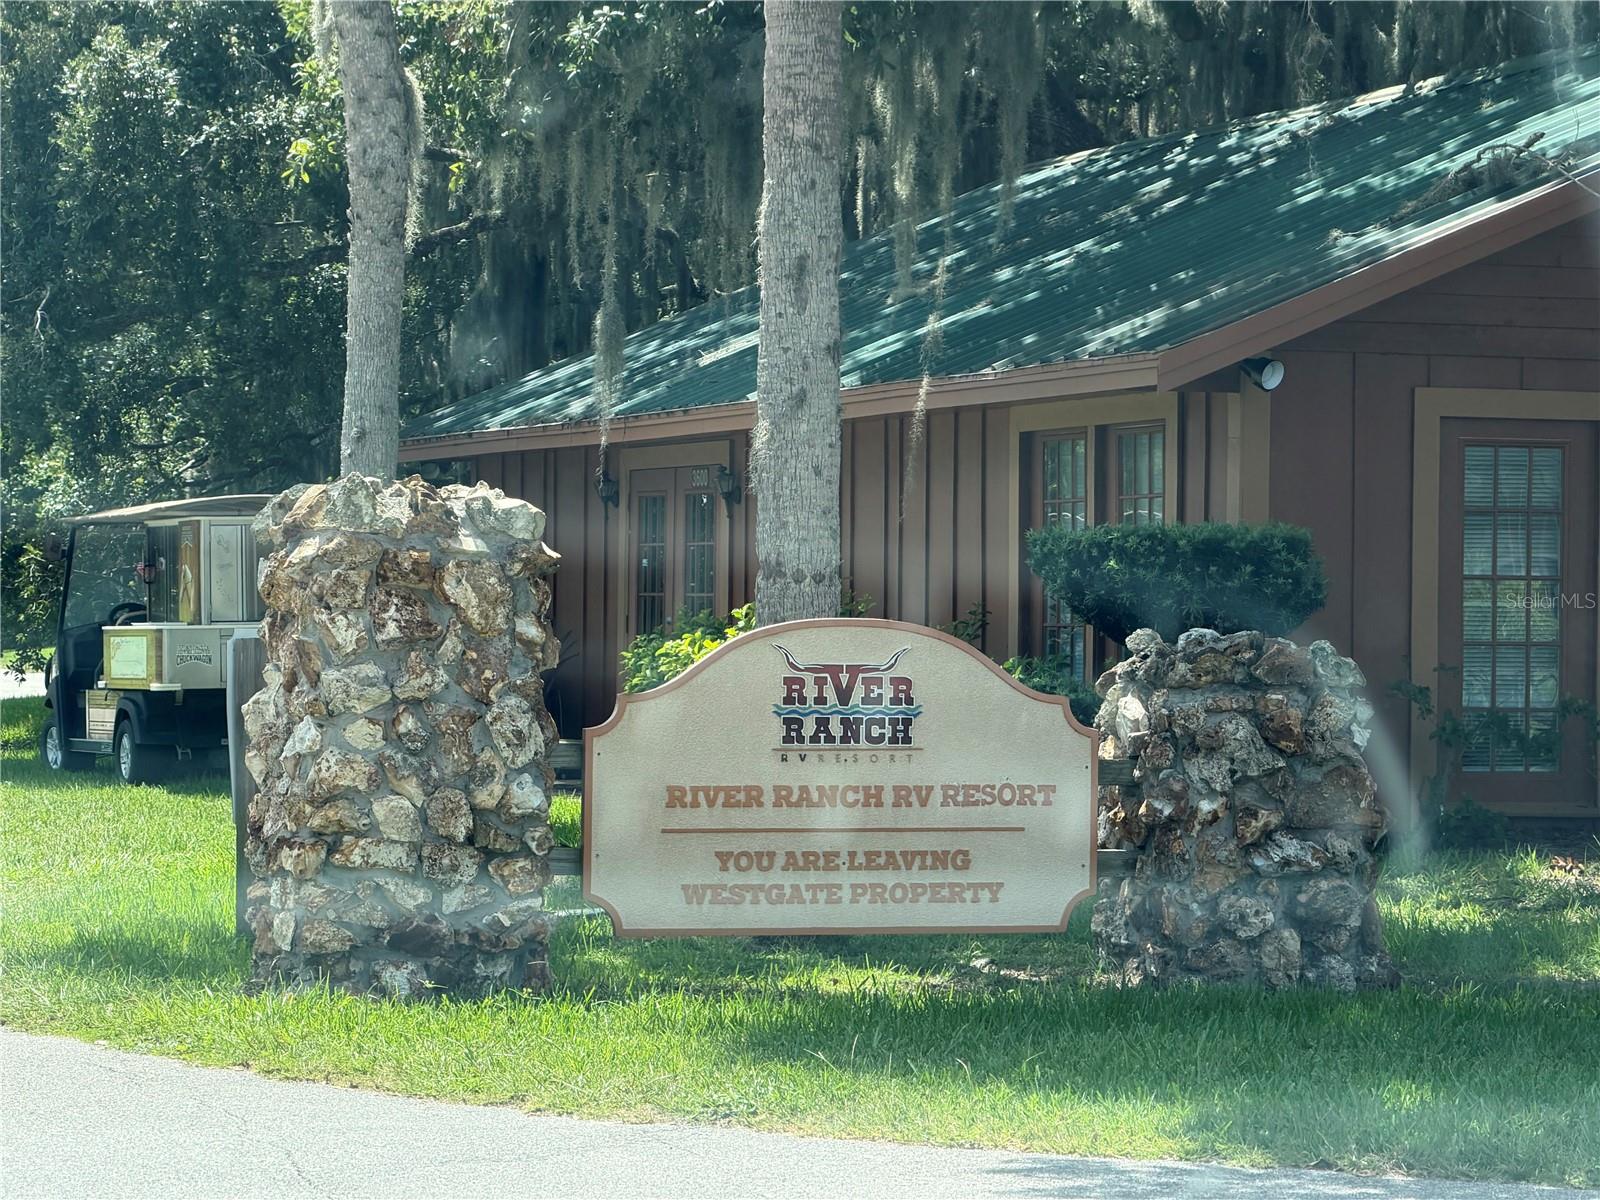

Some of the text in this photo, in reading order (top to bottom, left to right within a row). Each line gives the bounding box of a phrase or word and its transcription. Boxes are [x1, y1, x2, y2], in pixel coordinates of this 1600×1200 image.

[782, 664, 915, 707] RIVER
[781, 716, 914, 746] RANCH
[780, 753, 913, 764] RV RESORT
[665, 783, 1056, 809] RIVER RANCH RV RESORT
[714, 849, 971, 872] YOU ARE LEAVING
[681, 881, 1004, 905] WESTGATE PROPERTY
